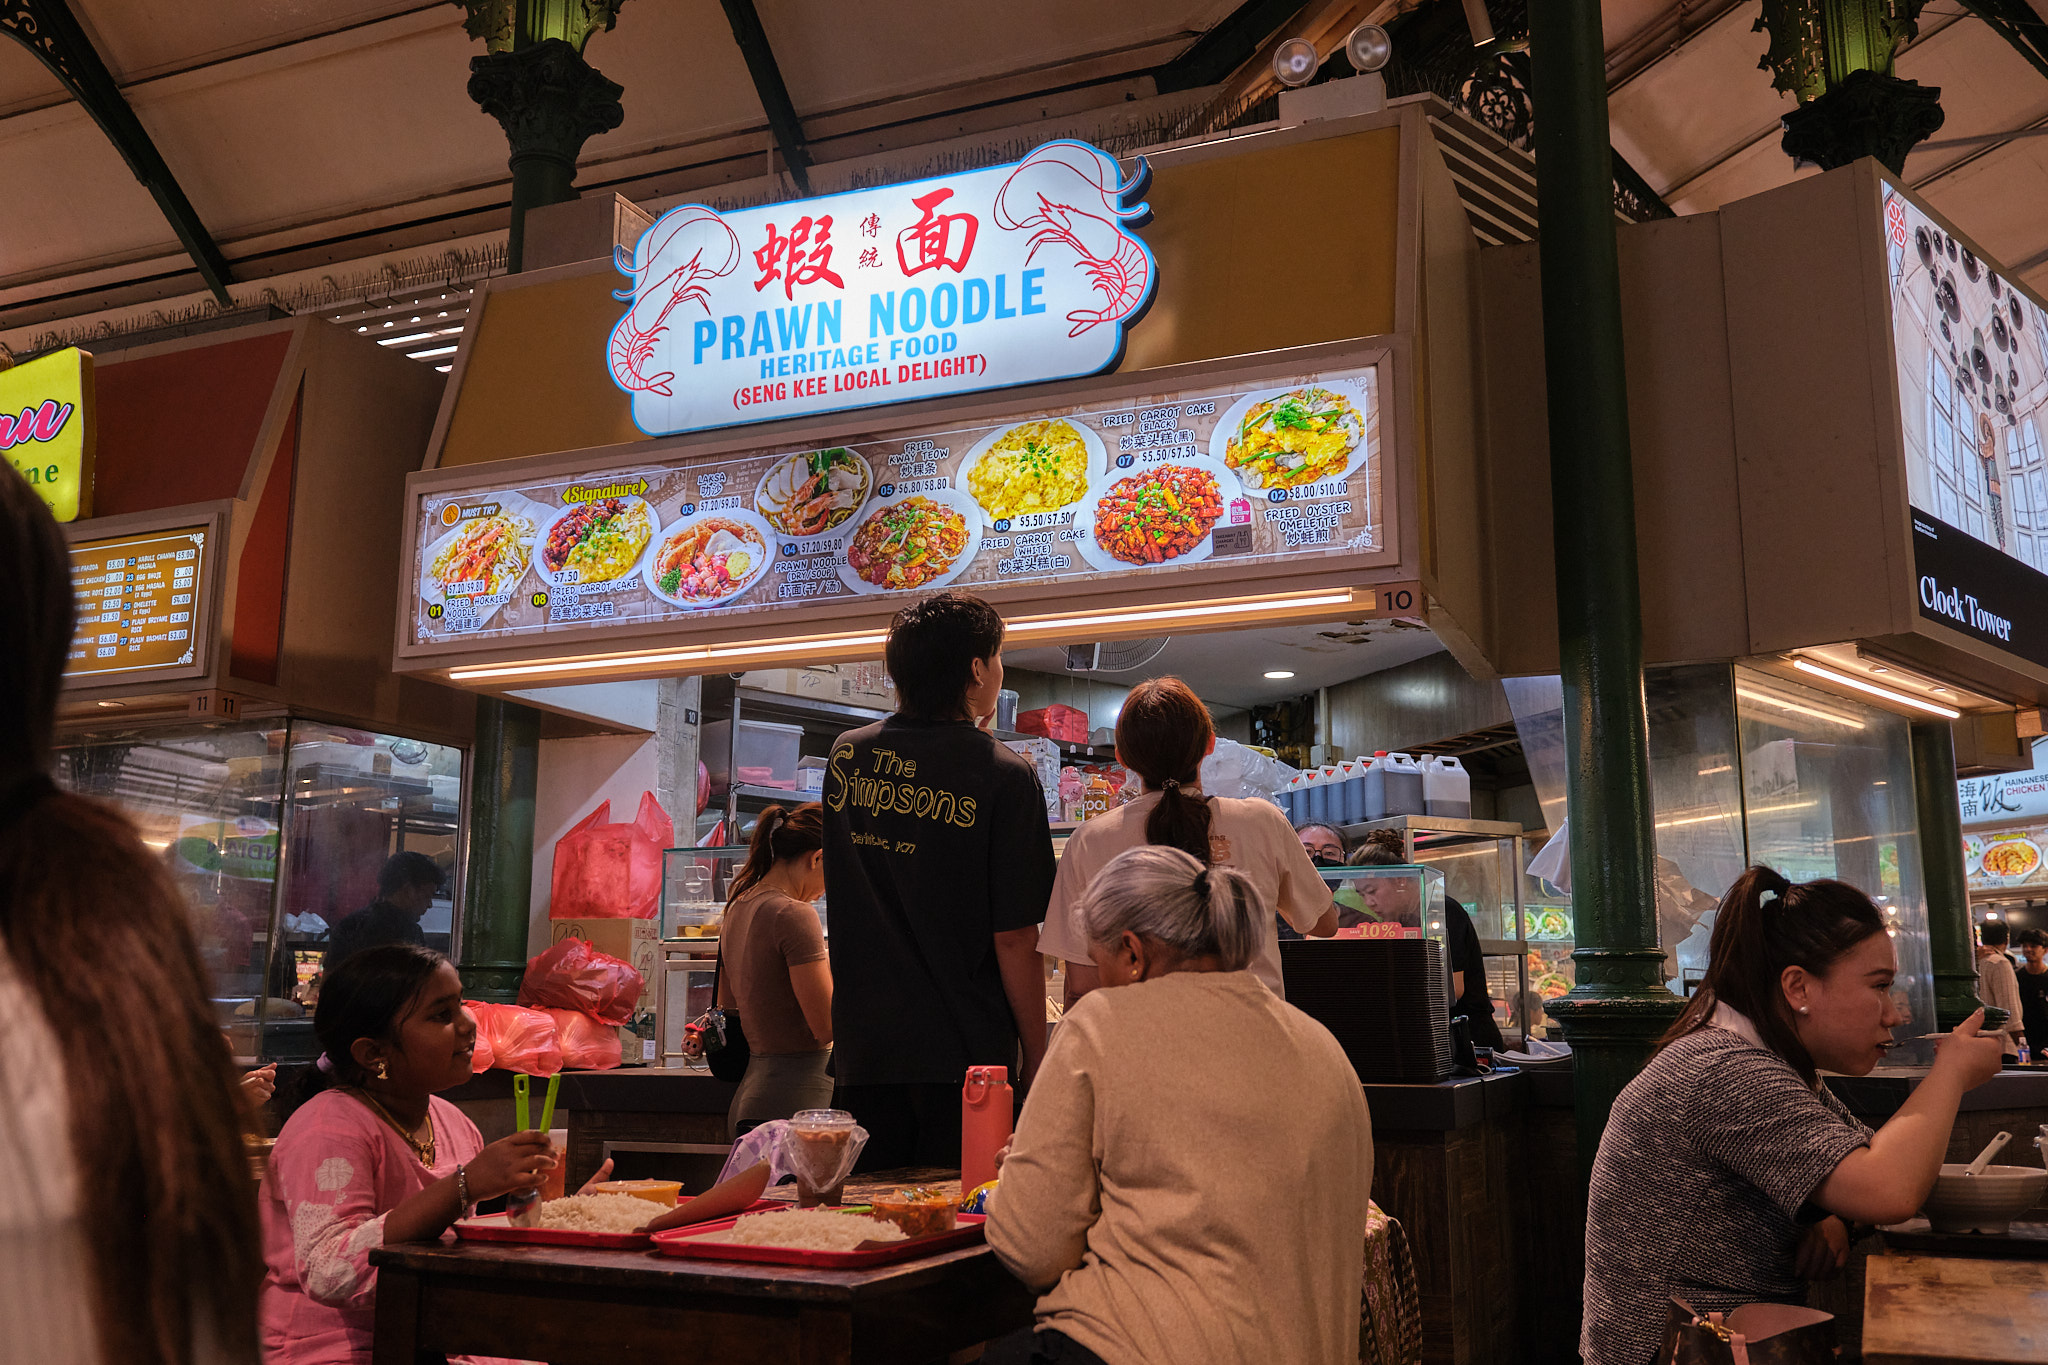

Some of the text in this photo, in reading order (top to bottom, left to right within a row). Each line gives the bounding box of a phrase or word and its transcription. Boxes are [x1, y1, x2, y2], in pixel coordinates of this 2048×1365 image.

[753, 188, 979, 301] 蝦 面
[694, 267, 1046, 365] PRAWN NOODLE
[760, 332, 957, 379] HERITAGE FOOD
[733, 354, 987, 410] (SENG KEE LOCAL DELIGHT)
[1103, 403, 1214, 427] FRIED CARROT CAKE
[1140, 420, 1177, 432] (BLACK)
[905, 441, 933, 453] FRIED
[889, 449, 949, 465] KWAY TEOW
[1118, 445, 1196, 466] 07 $5.50/$7.50
[698, 472, 726, 485] LAKSA
[880, 478, 947, 495] 05 $6.80/$8.80
[569, 483, 639, 506] Signature
[1270, 481, 1348, 501] 02 $8.00/$10.00
[461, 506, 497, 518] MUST TRY
[682, 504, 694, 515] 03
[1266, 502, 1350, 520] FRIED OYSTER
[995, 512, 1071, 531] 06 $5.50/$7.50
[1279, 516, 1337, 531] OMELETTE
[981, 529, 1086, 549] FRIED CARROT CAKE
[783, 545, 796, 555] 04
[1014, 544, 1051, 556] (WHITE)
[775, 556, 848, 573] PRAWN NOODLE
[554, 570, 578, 582] $7.50
[787, 568, 835, 581] (DRY/SOUP)
[551, 580, 638, 595] FRIED CARROT CAKE
[447, 594, 510, 608] FRIED HOKKIEN
[533, 593, 579, 606] 08 COMBO
[1384, 590, 1413, 611] 10
[429, 605, 477, 618] 01 NOODLE
[1920, 575, 2012, 642] Clock Tower
[197, 696, 208, 711] 11
[223, 697, 234, 714] 11
[688, 711, 697, 724] 10
[872, 747, 917, 779] The
[827, 742, 977, 828] Simpsons
[2004, 774, 2048, 787] HAINANESE
[2006, 784, 2046, 797] CHICKEN
